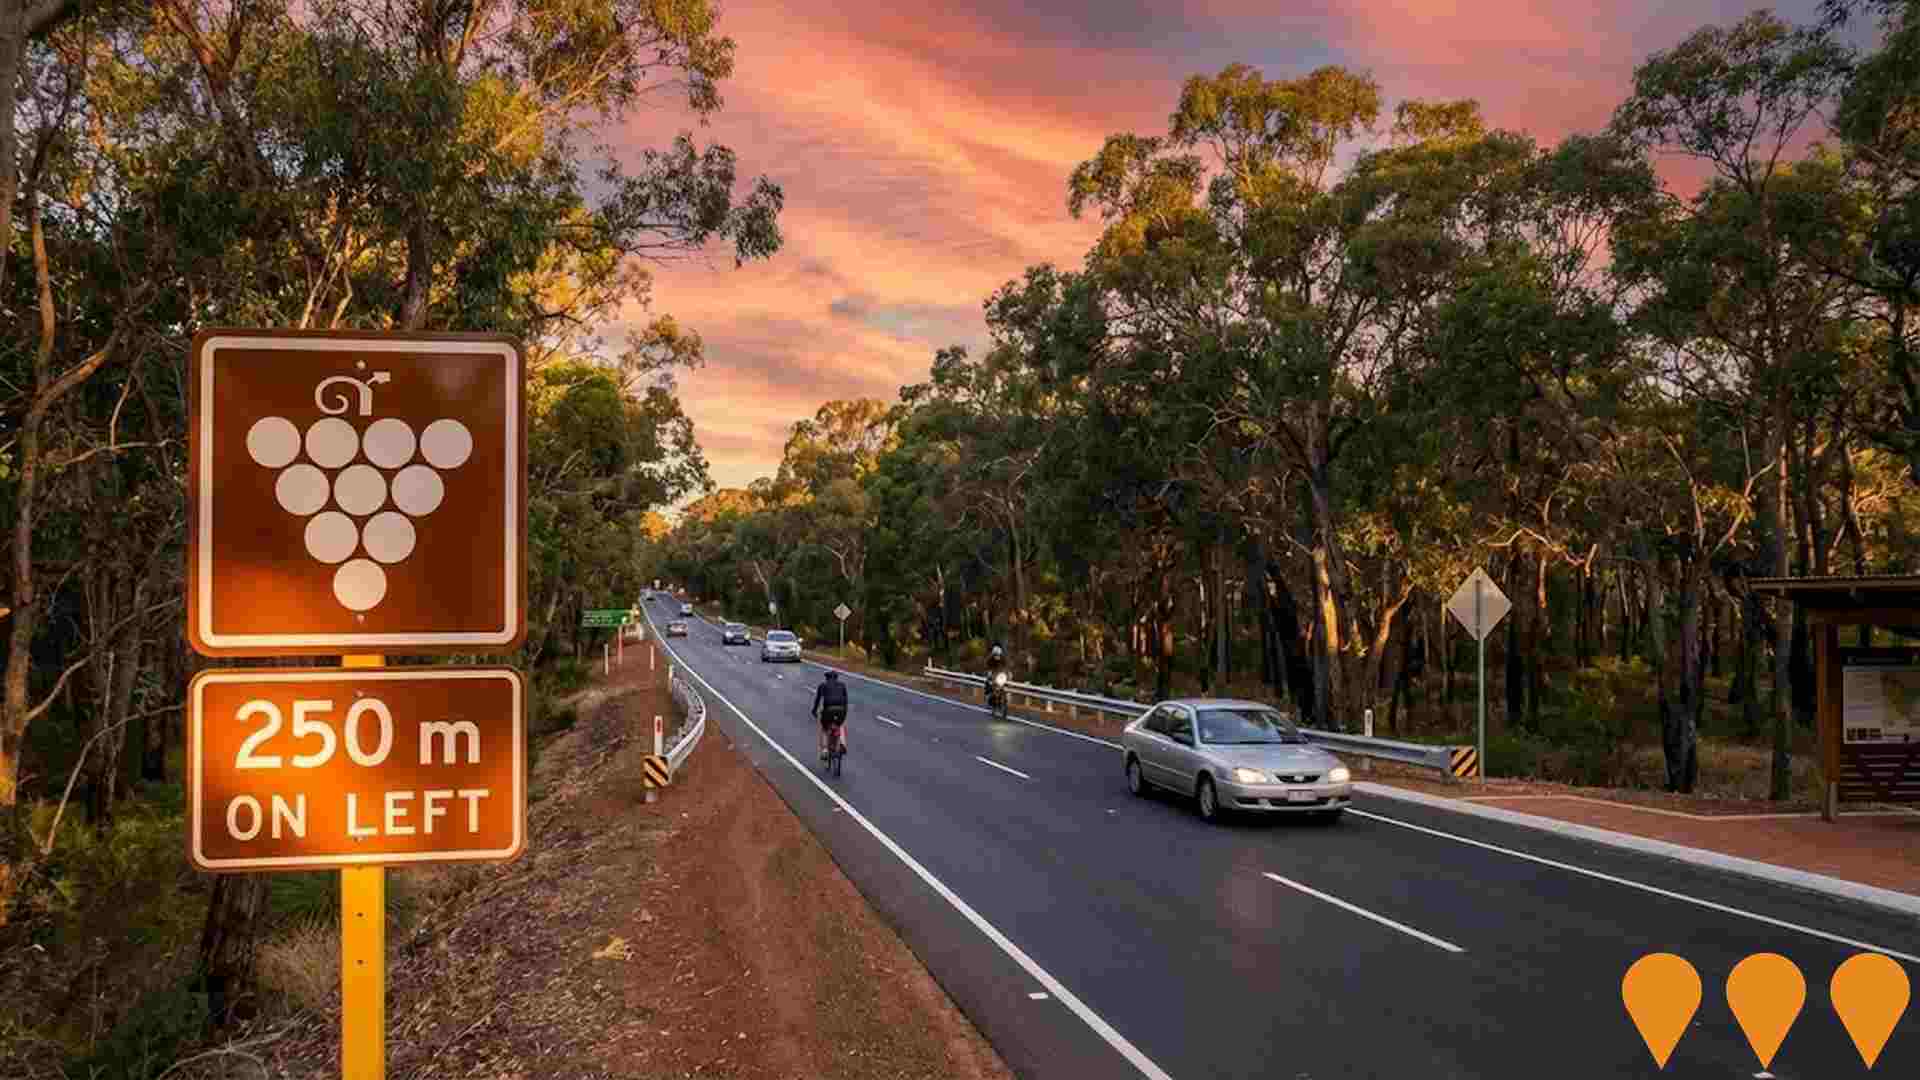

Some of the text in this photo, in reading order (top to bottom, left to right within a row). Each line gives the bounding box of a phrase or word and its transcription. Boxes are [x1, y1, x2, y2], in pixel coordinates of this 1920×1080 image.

[235, 698, 481, 769] 250 m
[226, 789, 489, 841] ON LEFT
